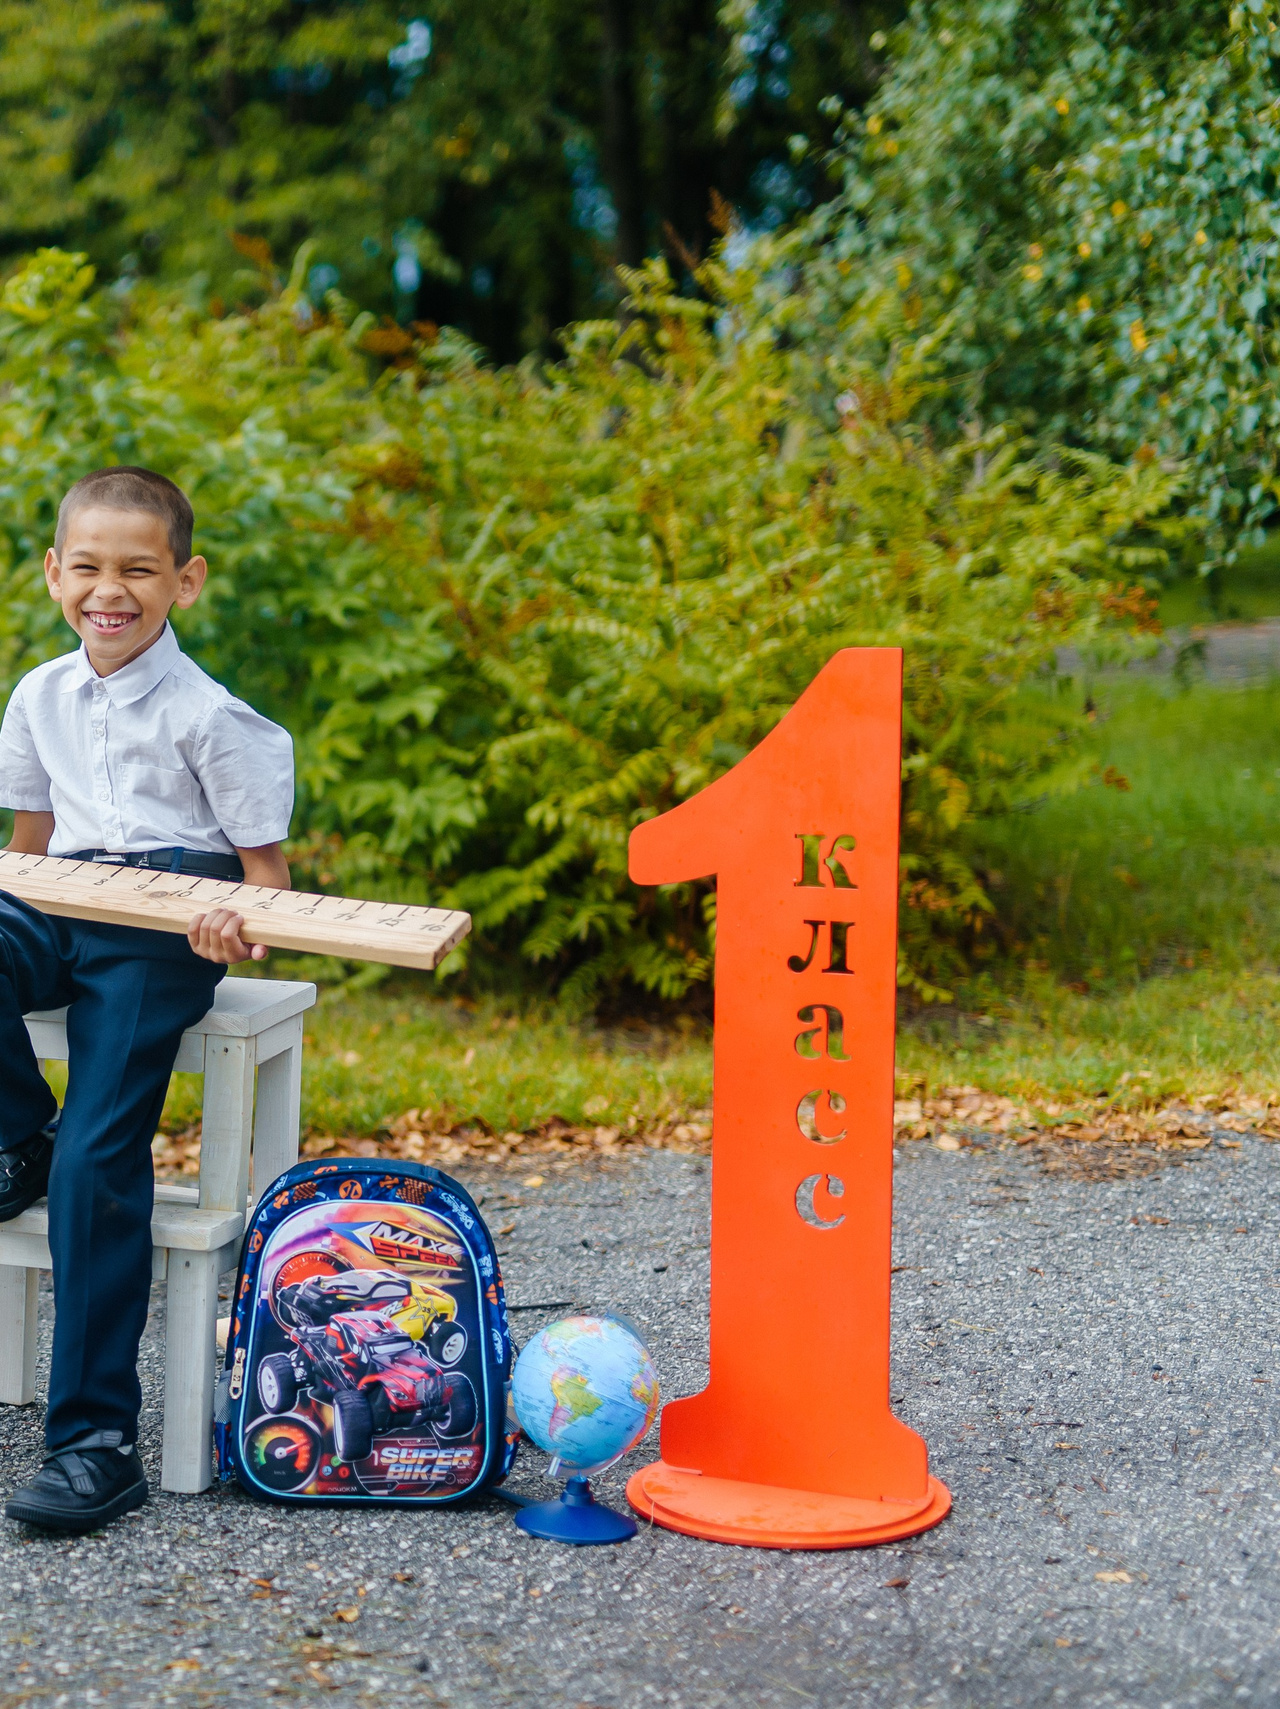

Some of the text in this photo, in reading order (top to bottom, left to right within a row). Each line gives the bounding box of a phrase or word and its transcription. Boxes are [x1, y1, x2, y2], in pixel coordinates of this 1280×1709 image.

[94, 878, 108, 886] 8
[133, 883, 146, 891] 9
[169, 890, 193, 898] 10
[209, 895, 233, 903] 11
[252, 902, 273, 910] 12
[294, 907, 317, 915] 13
[333, 912, 360, 921] 14
[377, 918, 405, 927] 15
[421, 924, 447, 932] 16
[787, 832, 858, 1231] класс
[628, 647, 929, 1506] 1
[370, 1237, 458, 1266] SPEED
[374, 1223, 442, 1252] MAX
[380, 1447, 474, 1466] SUPER
[386, 1464, 450, 1481] BIKE
